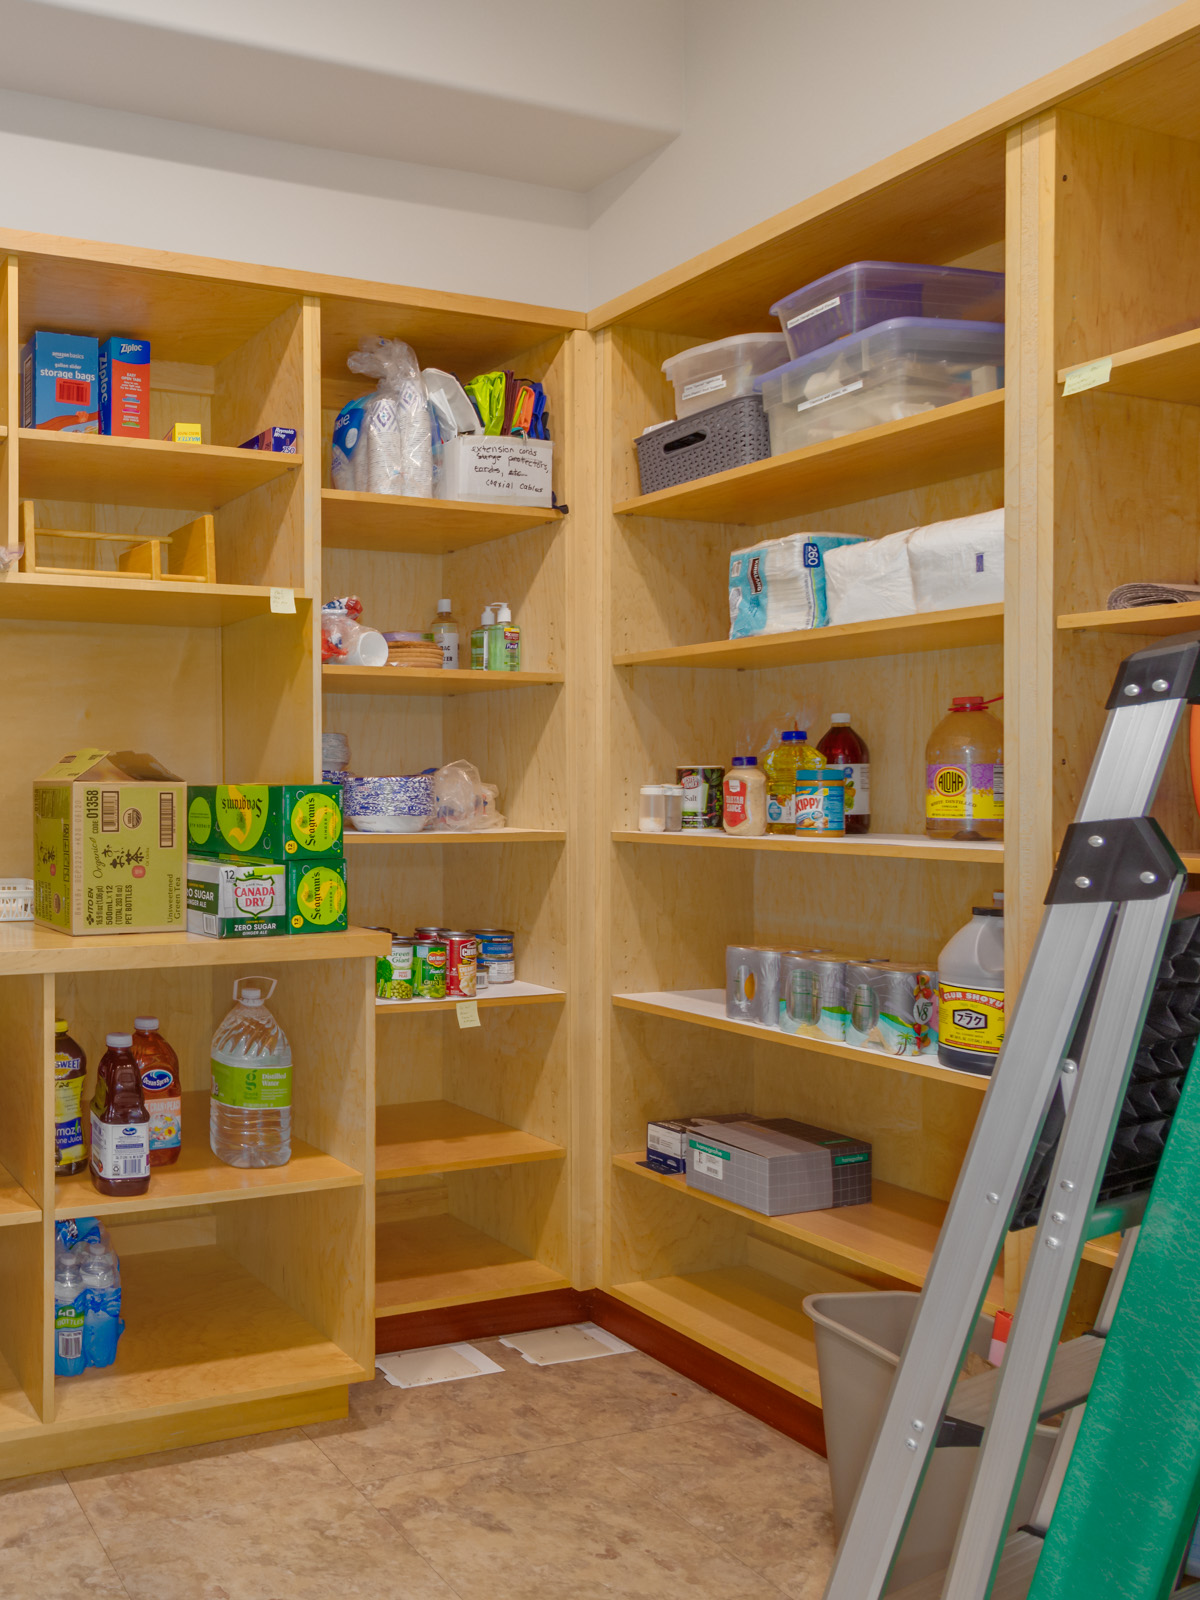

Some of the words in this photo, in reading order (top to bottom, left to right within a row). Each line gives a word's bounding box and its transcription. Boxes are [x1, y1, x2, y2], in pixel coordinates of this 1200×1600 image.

[120, 343, 143, 354] Ziploc
[40, 368, 73, 379] storage
[75, 371, 96, 383] bags
[99, 352, 108, 403] Ziploc
[275, 427, 294, 435] Reynolds
[471, 445, 514, 453] extension
[519, 448, 537, 457] cords
[808, 545, 818, 566] 260
[753, 559, 762, 592] KIRKLAND
[938, 771, 964, 793] ALOHA
[684, 794, 697, 802] Salt
[725, 795, 745, 805] TARTAR
[86, 789, 99, 819] 01358
[222, 795, 263, 818] Seagram's
[726, 804, 743, 813] SAUCE
[305, 797, 317, 846] Seagram's
[287, 843, 293, 851] 12
[224, 870, 235, 880] 12
[234, 886, 276, 897] CANADA
[311, 871, 322, 920] Seagram's
[125, 884, 133, 912] BOTTLES
[245, 897, 266, 907] DRY
[125, 913, 133, 925] PET
[293, 917, 299, 925] 12
[234, 924, 252, 932] ZERO
[391, 956, 410, 964] Giant
[944, 992, 963, 1000] CLUB
[966, 993, 1004, 1008] SHOYU
[916, 1004, 929, 1022] V8
[143, 1077, 157, 1087] Ocean
[156, 1076, 170, 1086] Spray
[696, 1142, 723, 1157] hansgrohe
[841, 1155, 864, 1164] hansgrohe
[58, 1308, 76, 1318] 40
[56, 1318, 84, 1326] BOTTLES
